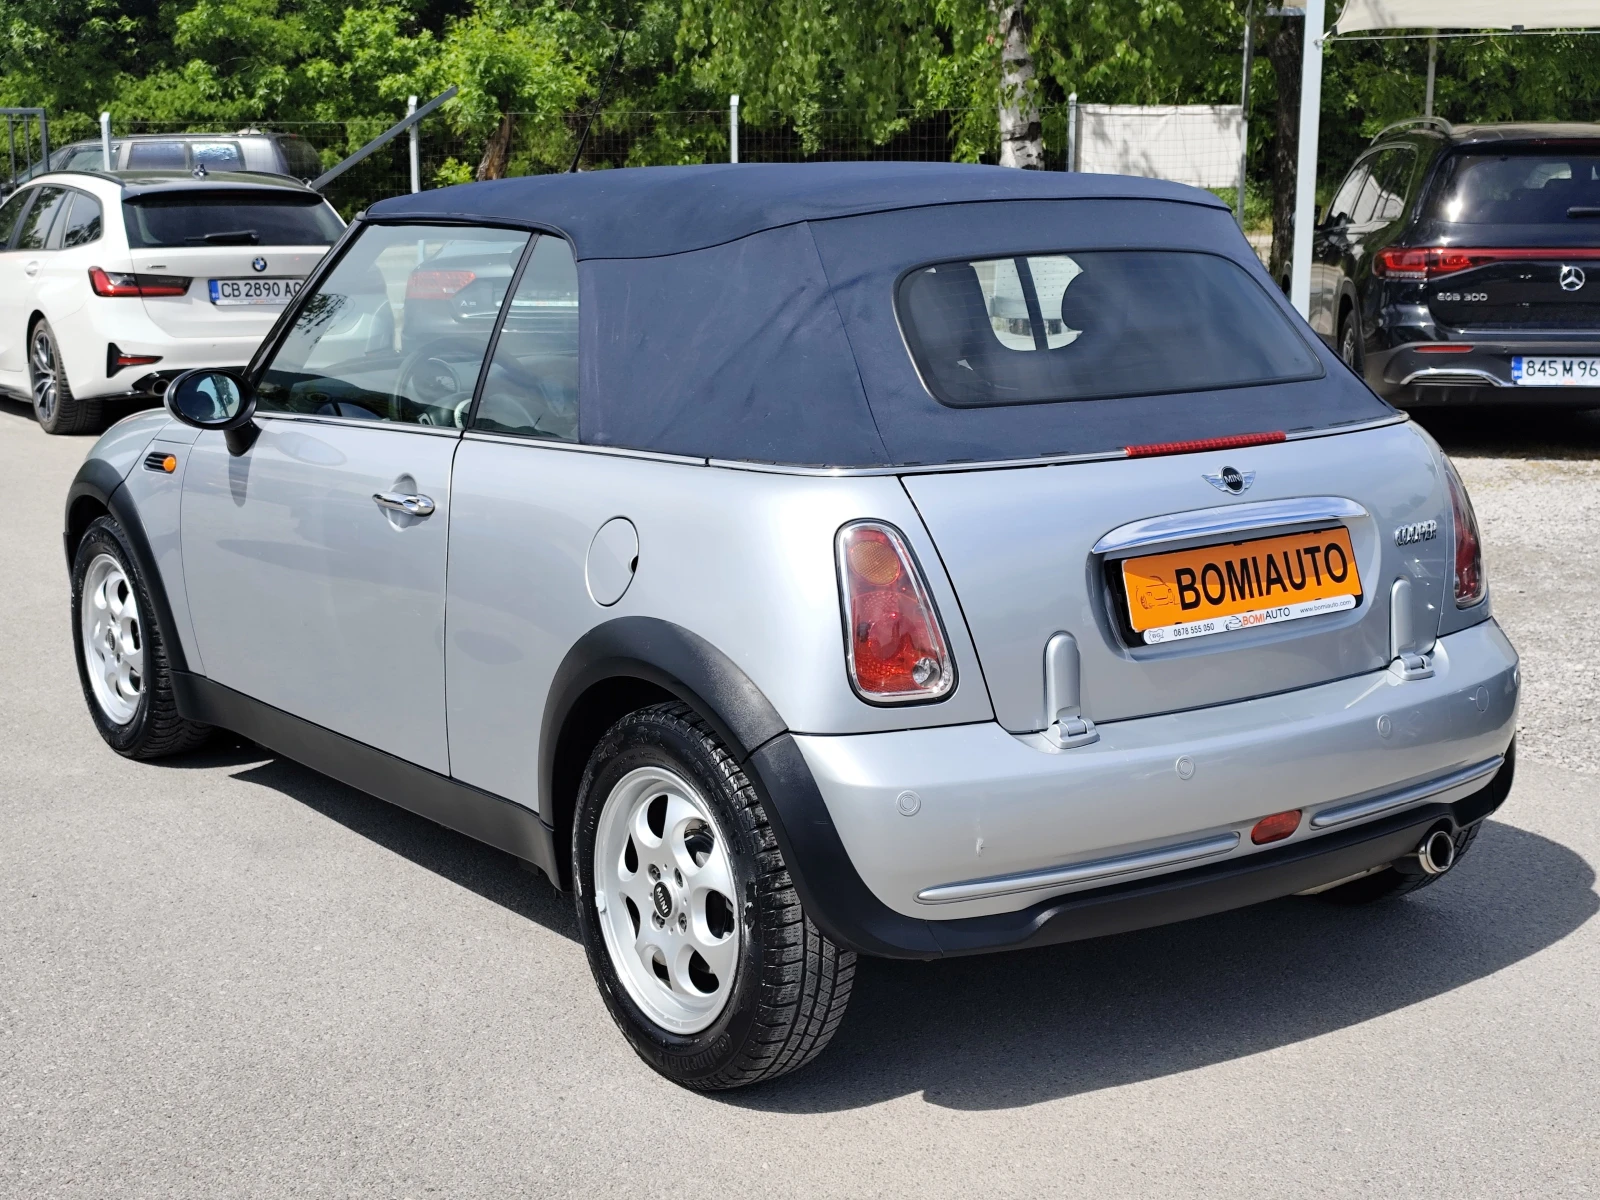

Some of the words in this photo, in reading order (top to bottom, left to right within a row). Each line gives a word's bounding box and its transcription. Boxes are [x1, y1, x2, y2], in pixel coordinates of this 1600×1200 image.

[221, 282, 241, 298] CB
[245, 282, 280, 297] 2890
[1463, 292, 1488, 301] 300
[1526, 360, 1558, 376] 845
[1562, 360, 1574, 377] M
[1577, 360, 1599, 377] 96
[1223, 473, 1243, 483] MINI
[1174, 542, 1349, 611] BOMIAUTO
[1300, 599, 1352, 614] www.bomiauto.com
[1242, 607, 1291, 626] BOMIAUTO
[656, 886, 669, 914] MINI
